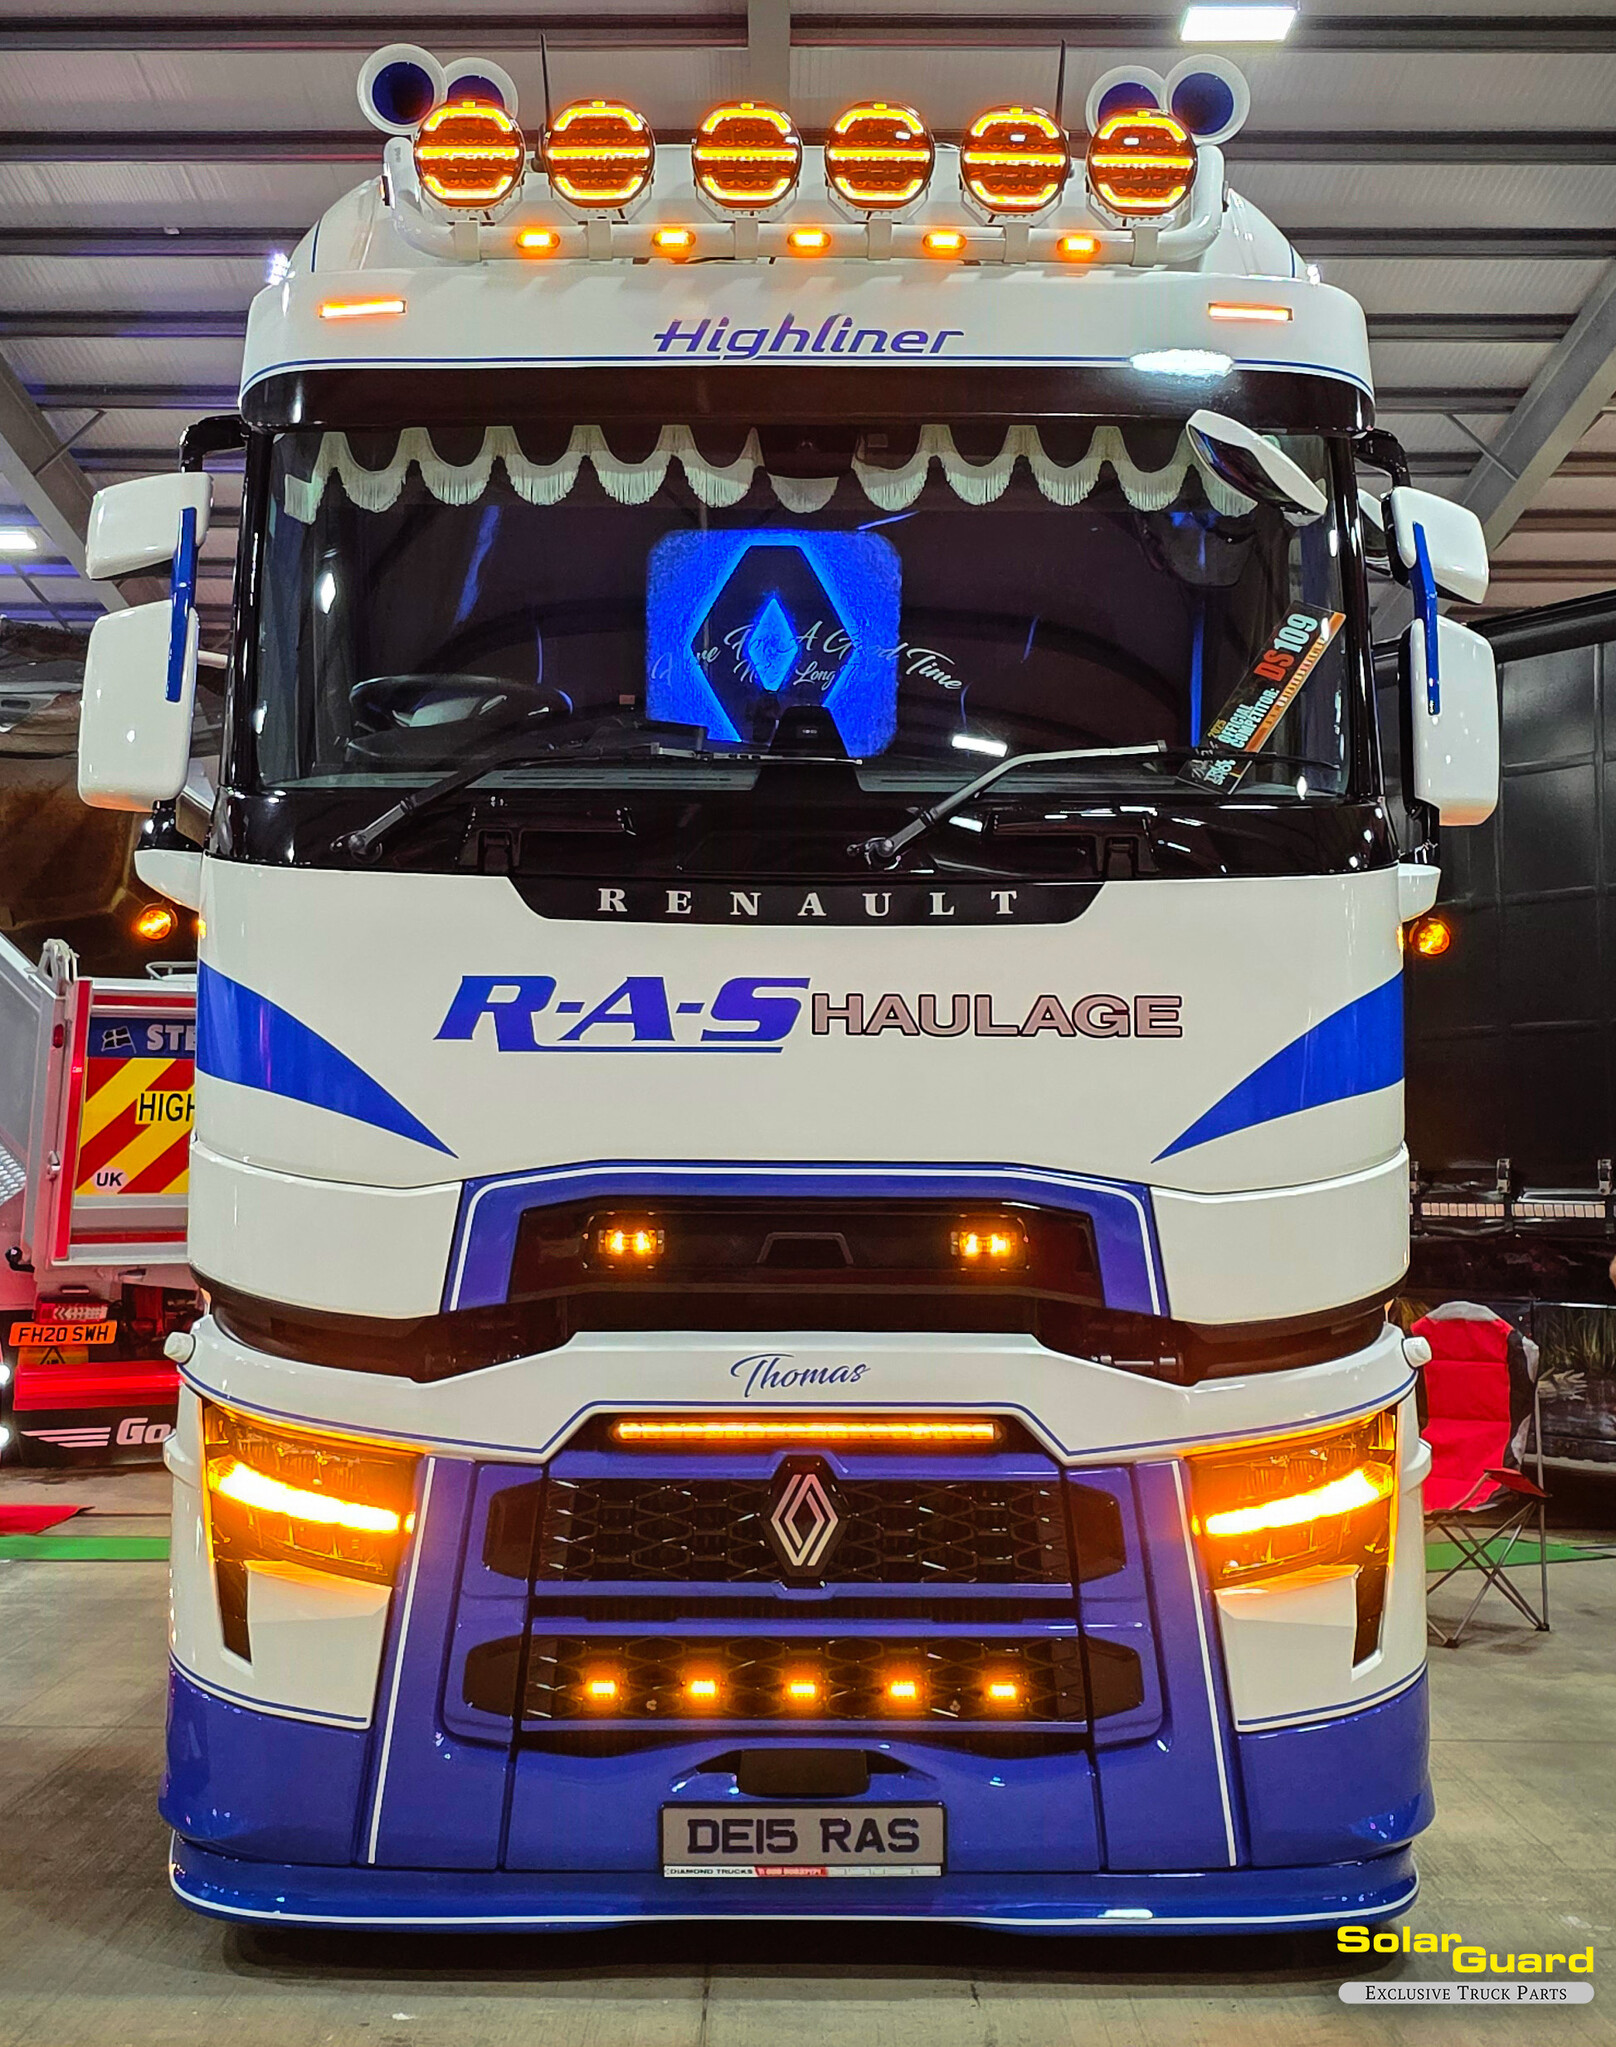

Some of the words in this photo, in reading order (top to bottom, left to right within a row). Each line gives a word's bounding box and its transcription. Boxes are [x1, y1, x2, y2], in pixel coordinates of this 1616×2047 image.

[653, 313, 965, 360] Highliner
[796, 620, 823, 651] A
[906, 648, 963, 690] Time
[793, 661, 836, 691] Long
[1207, 719, 1227, 739] 2025
[1217, 703, 1254, 745] OFFICIAL
[1231, 687, 1280, 749] COMPETITOR:
[597, 887, 1017, 917] RENAULT
[432, 975, 811, 1053] R-A-S
[812, 993, 1183, 1038] HAULAGE
[96, 1172, 124, 1187] UK
[18, 1327, 67, 1343] FH20
[72, 1325, 109, 1341] SWH
[730, 1353, 871, 1398] Thomas
[819, 1818, 920, 1853] RAS
